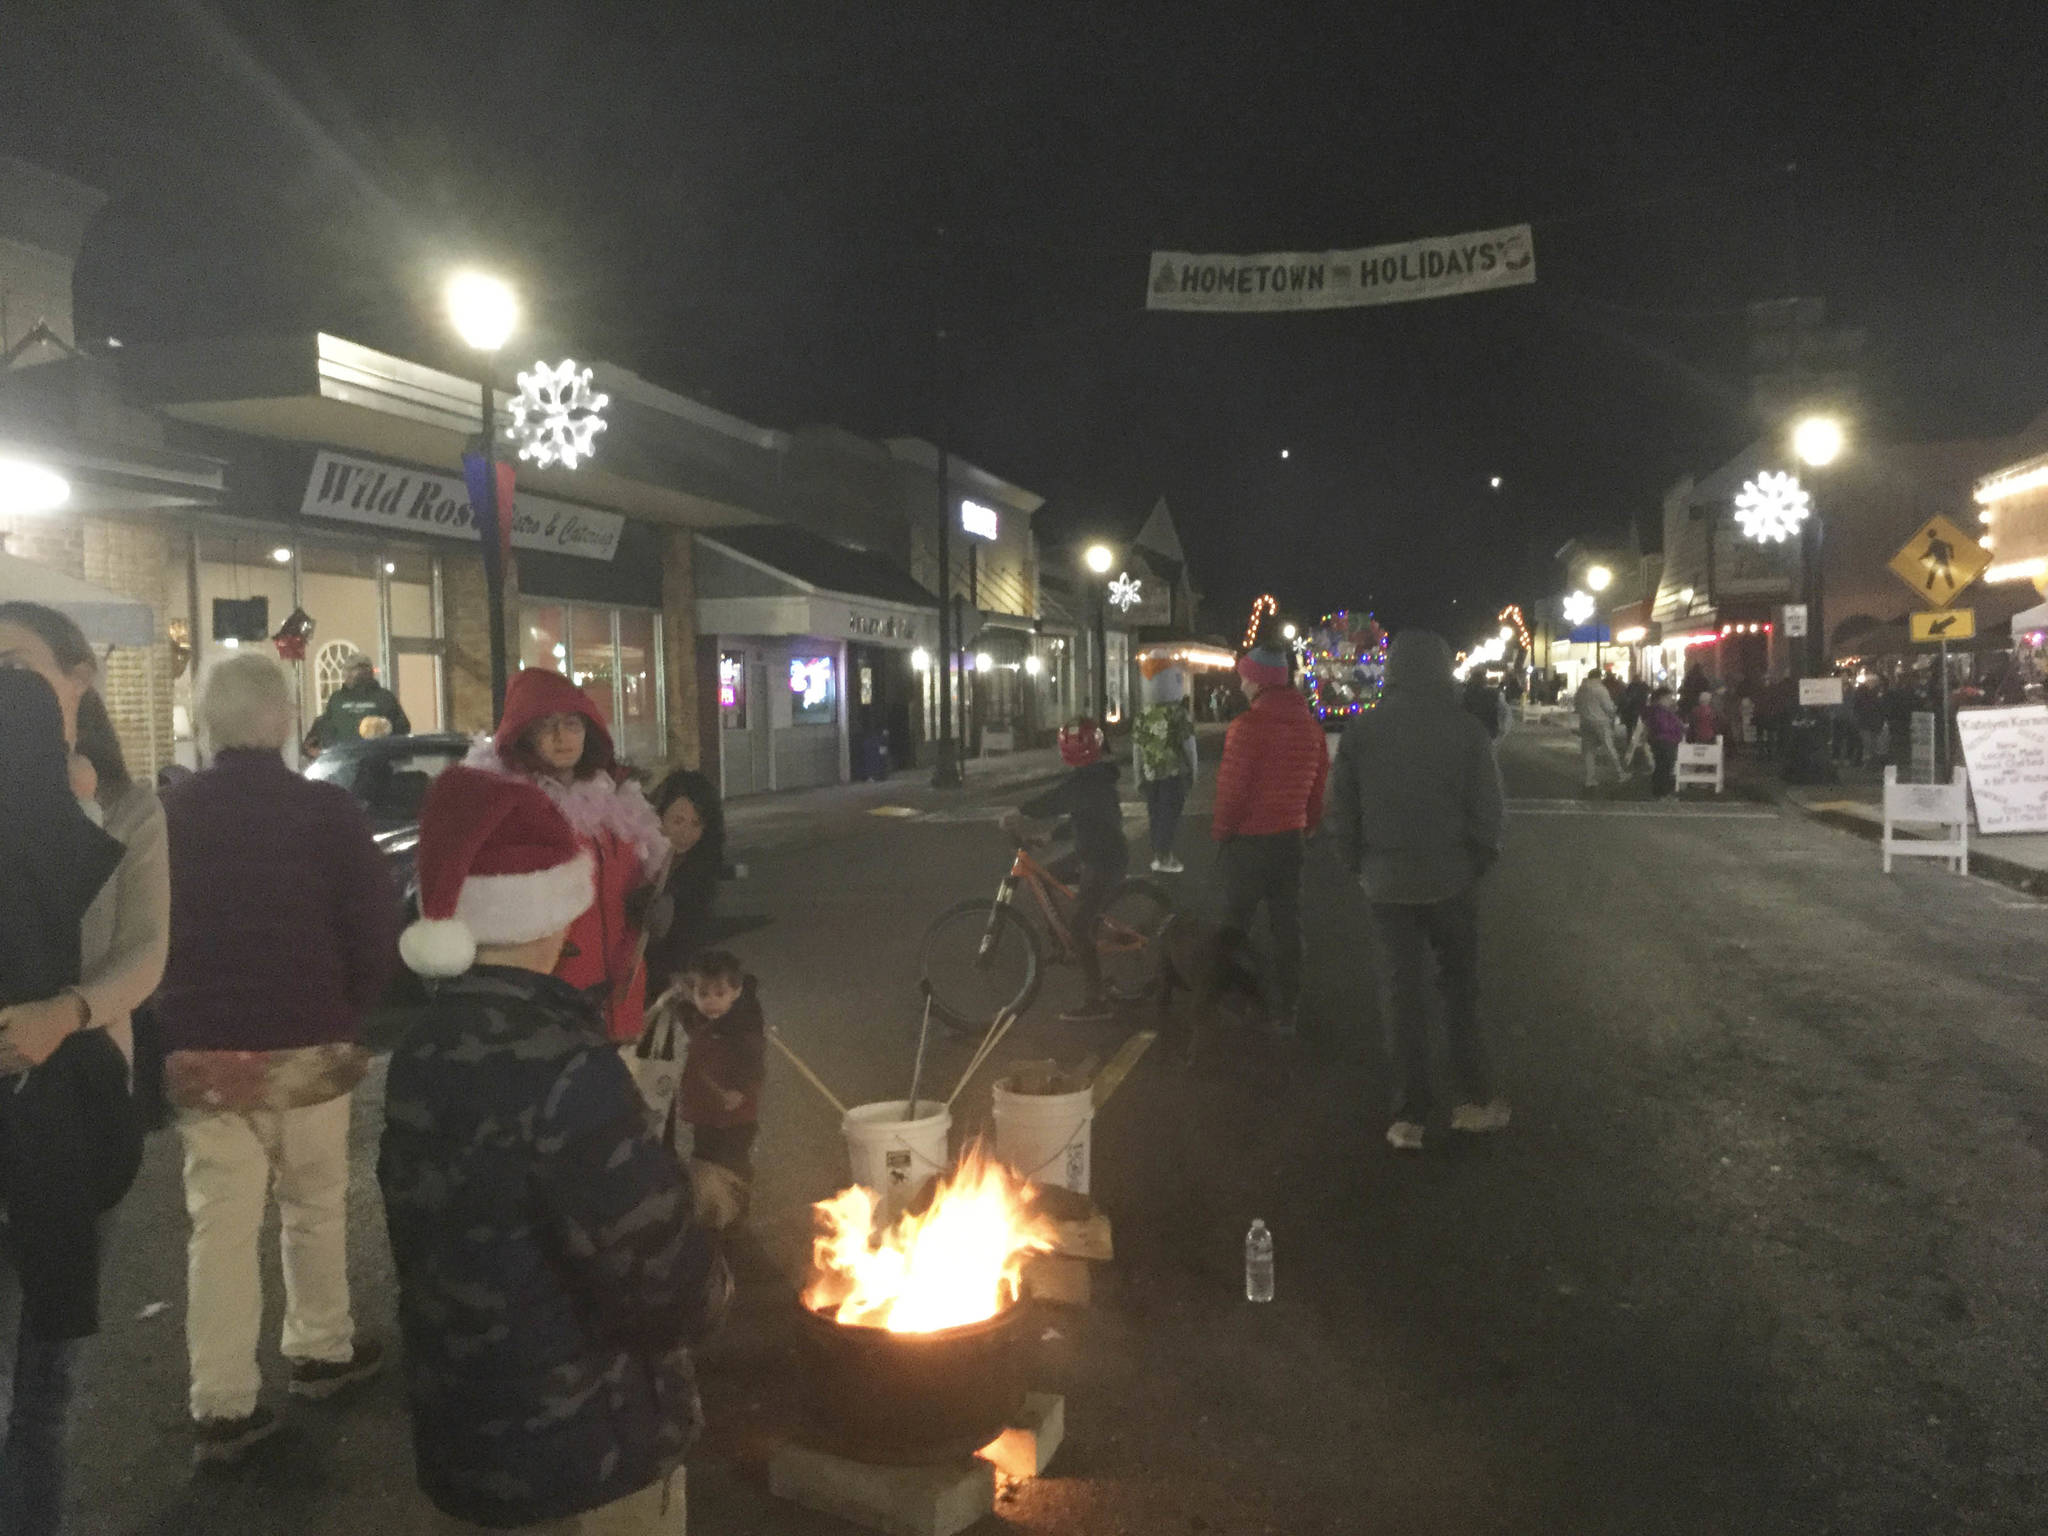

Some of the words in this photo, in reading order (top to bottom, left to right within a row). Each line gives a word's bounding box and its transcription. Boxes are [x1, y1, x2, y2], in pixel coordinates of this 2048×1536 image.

[1179, 263, 1325, 294] HOMETOWN
[1360, 246, 1497, 287] HOLIDAYS
[318, 461, 408, 515] Wild
[408, 481, 478, 530] Ros
